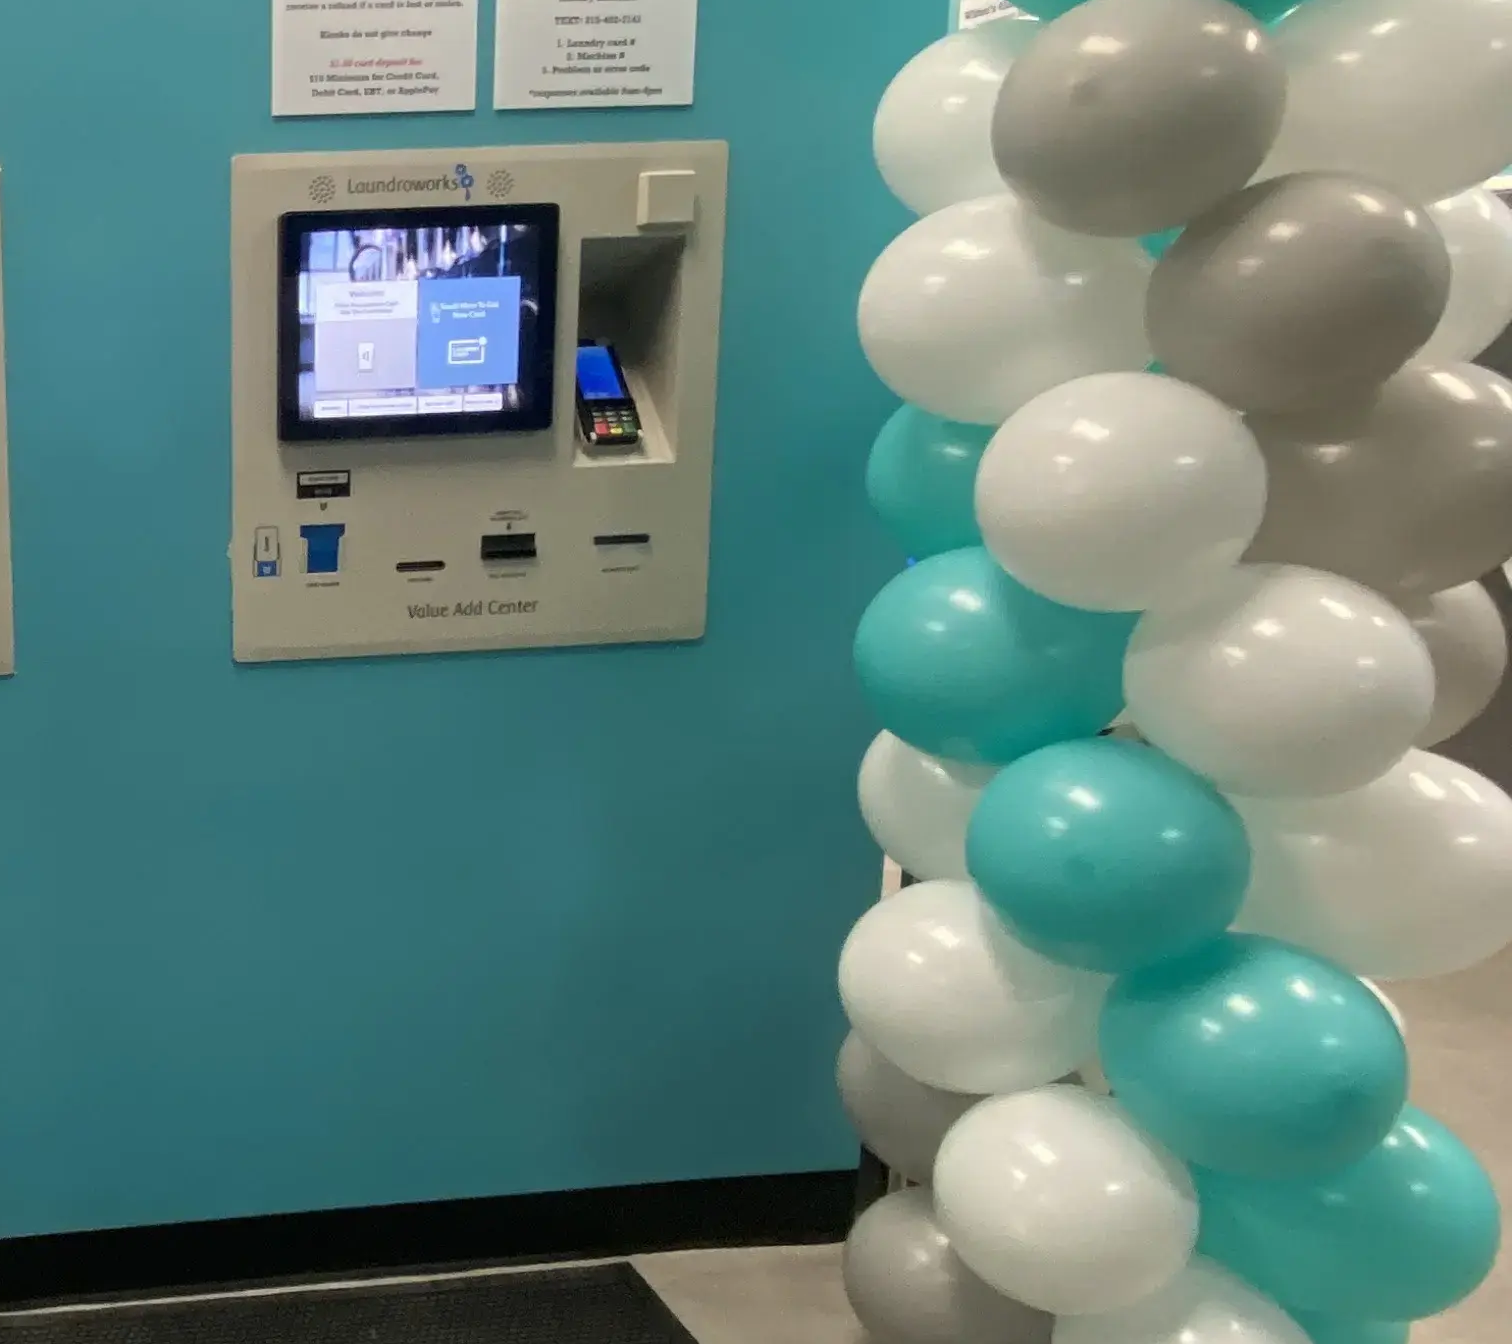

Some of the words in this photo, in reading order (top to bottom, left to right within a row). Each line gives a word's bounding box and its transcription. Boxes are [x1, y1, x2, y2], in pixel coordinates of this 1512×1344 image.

[348, 175, 458, 194] Laundroworks
[408, 603, 448, 620] Value
[453, 601, 482, 617] Add
[488, 599, 538, 616] Center
